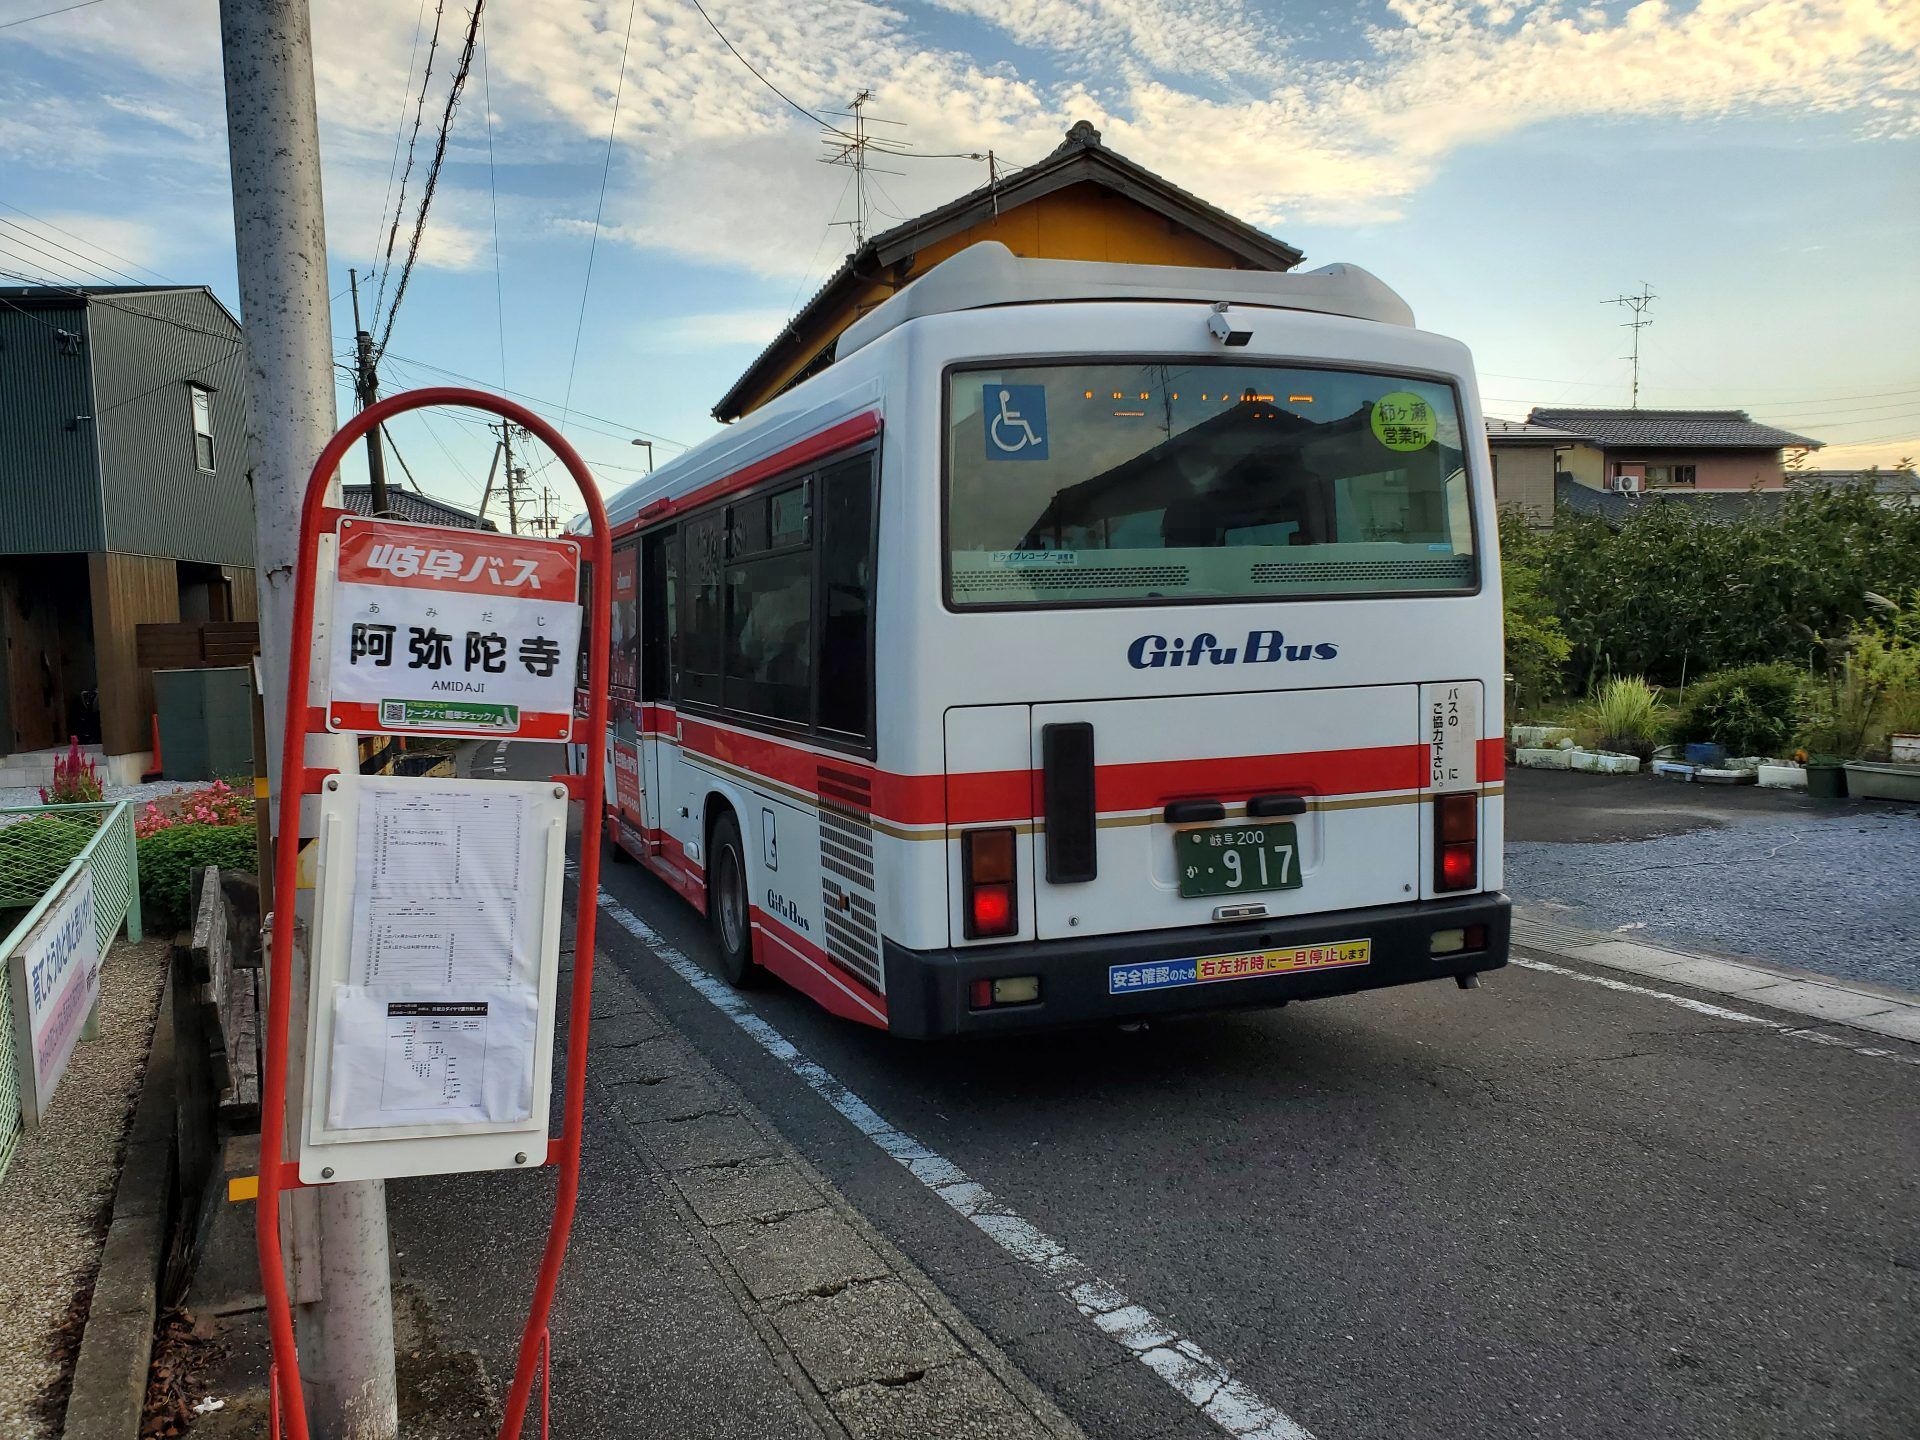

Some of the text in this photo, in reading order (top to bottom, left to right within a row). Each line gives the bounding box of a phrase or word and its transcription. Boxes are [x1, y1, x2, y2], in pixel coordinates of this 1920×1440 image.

[1383, 426, 1427, 445] 営業所
[366, 544, 542, 589] 岐阜バス
[351, 622, 561, 677] 阿弥陀寺
[1127, 630, 1339, 669] Gifu Bus
[432, 681, 485, 693] AMIDAJI
[1432, 703, 1443, 787] ご協力下さい。
[767, 888, 810, 931] Gifu Bus
